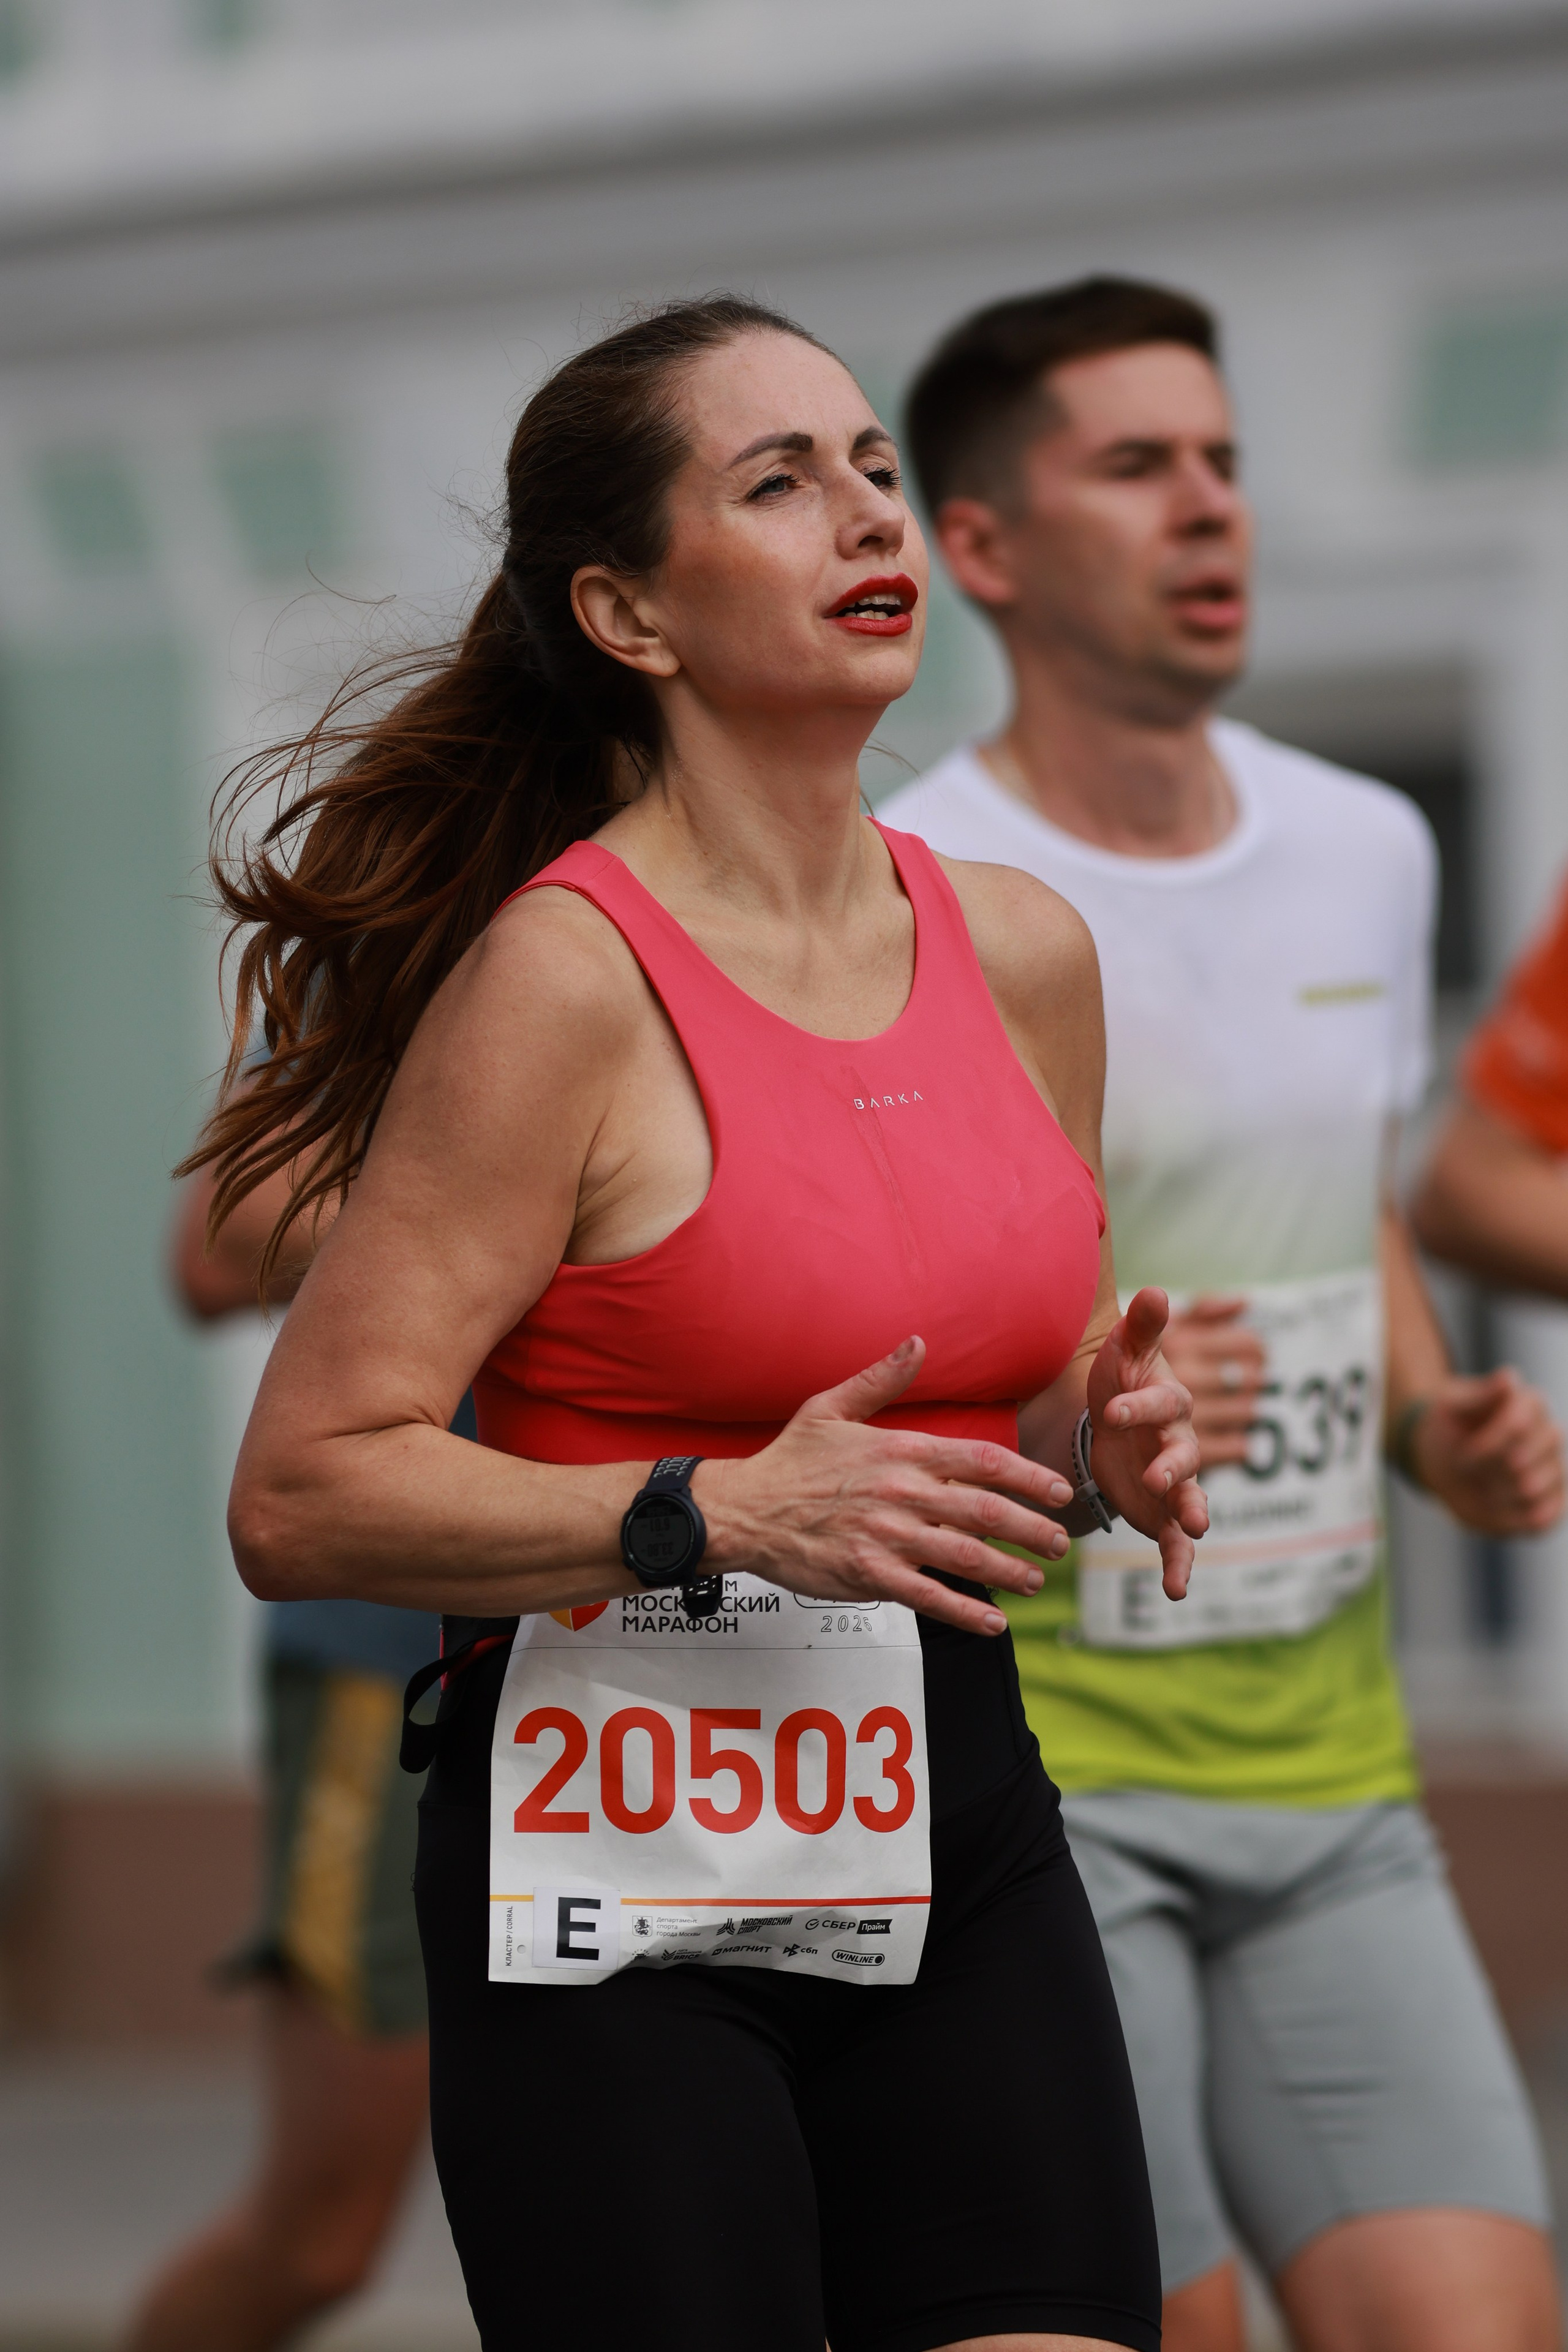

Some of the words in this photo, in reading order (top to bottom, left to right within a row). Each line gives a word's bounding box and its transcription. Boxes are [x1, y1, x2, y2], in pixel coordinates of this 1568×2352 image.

[853, 1090, 924, 1110] BARKA
[622, 1593, 780, 1613] МОСКСКИЙ
[622, 1616, 739, 1634] МАРАФОН
[513, 1706, 916, 1835] 20503
[556, 1896, 601, 1961] E
[737, 1925, 763, 1935] СПОРТ
[740, 1915, 794, 1927] МОСКОВСКИЙ
[821, 1920, 856, 1930] СБЕР
[861, 1922, 886, 1932] Прайм
[835, 1951, 875, 1964] WINLINE
